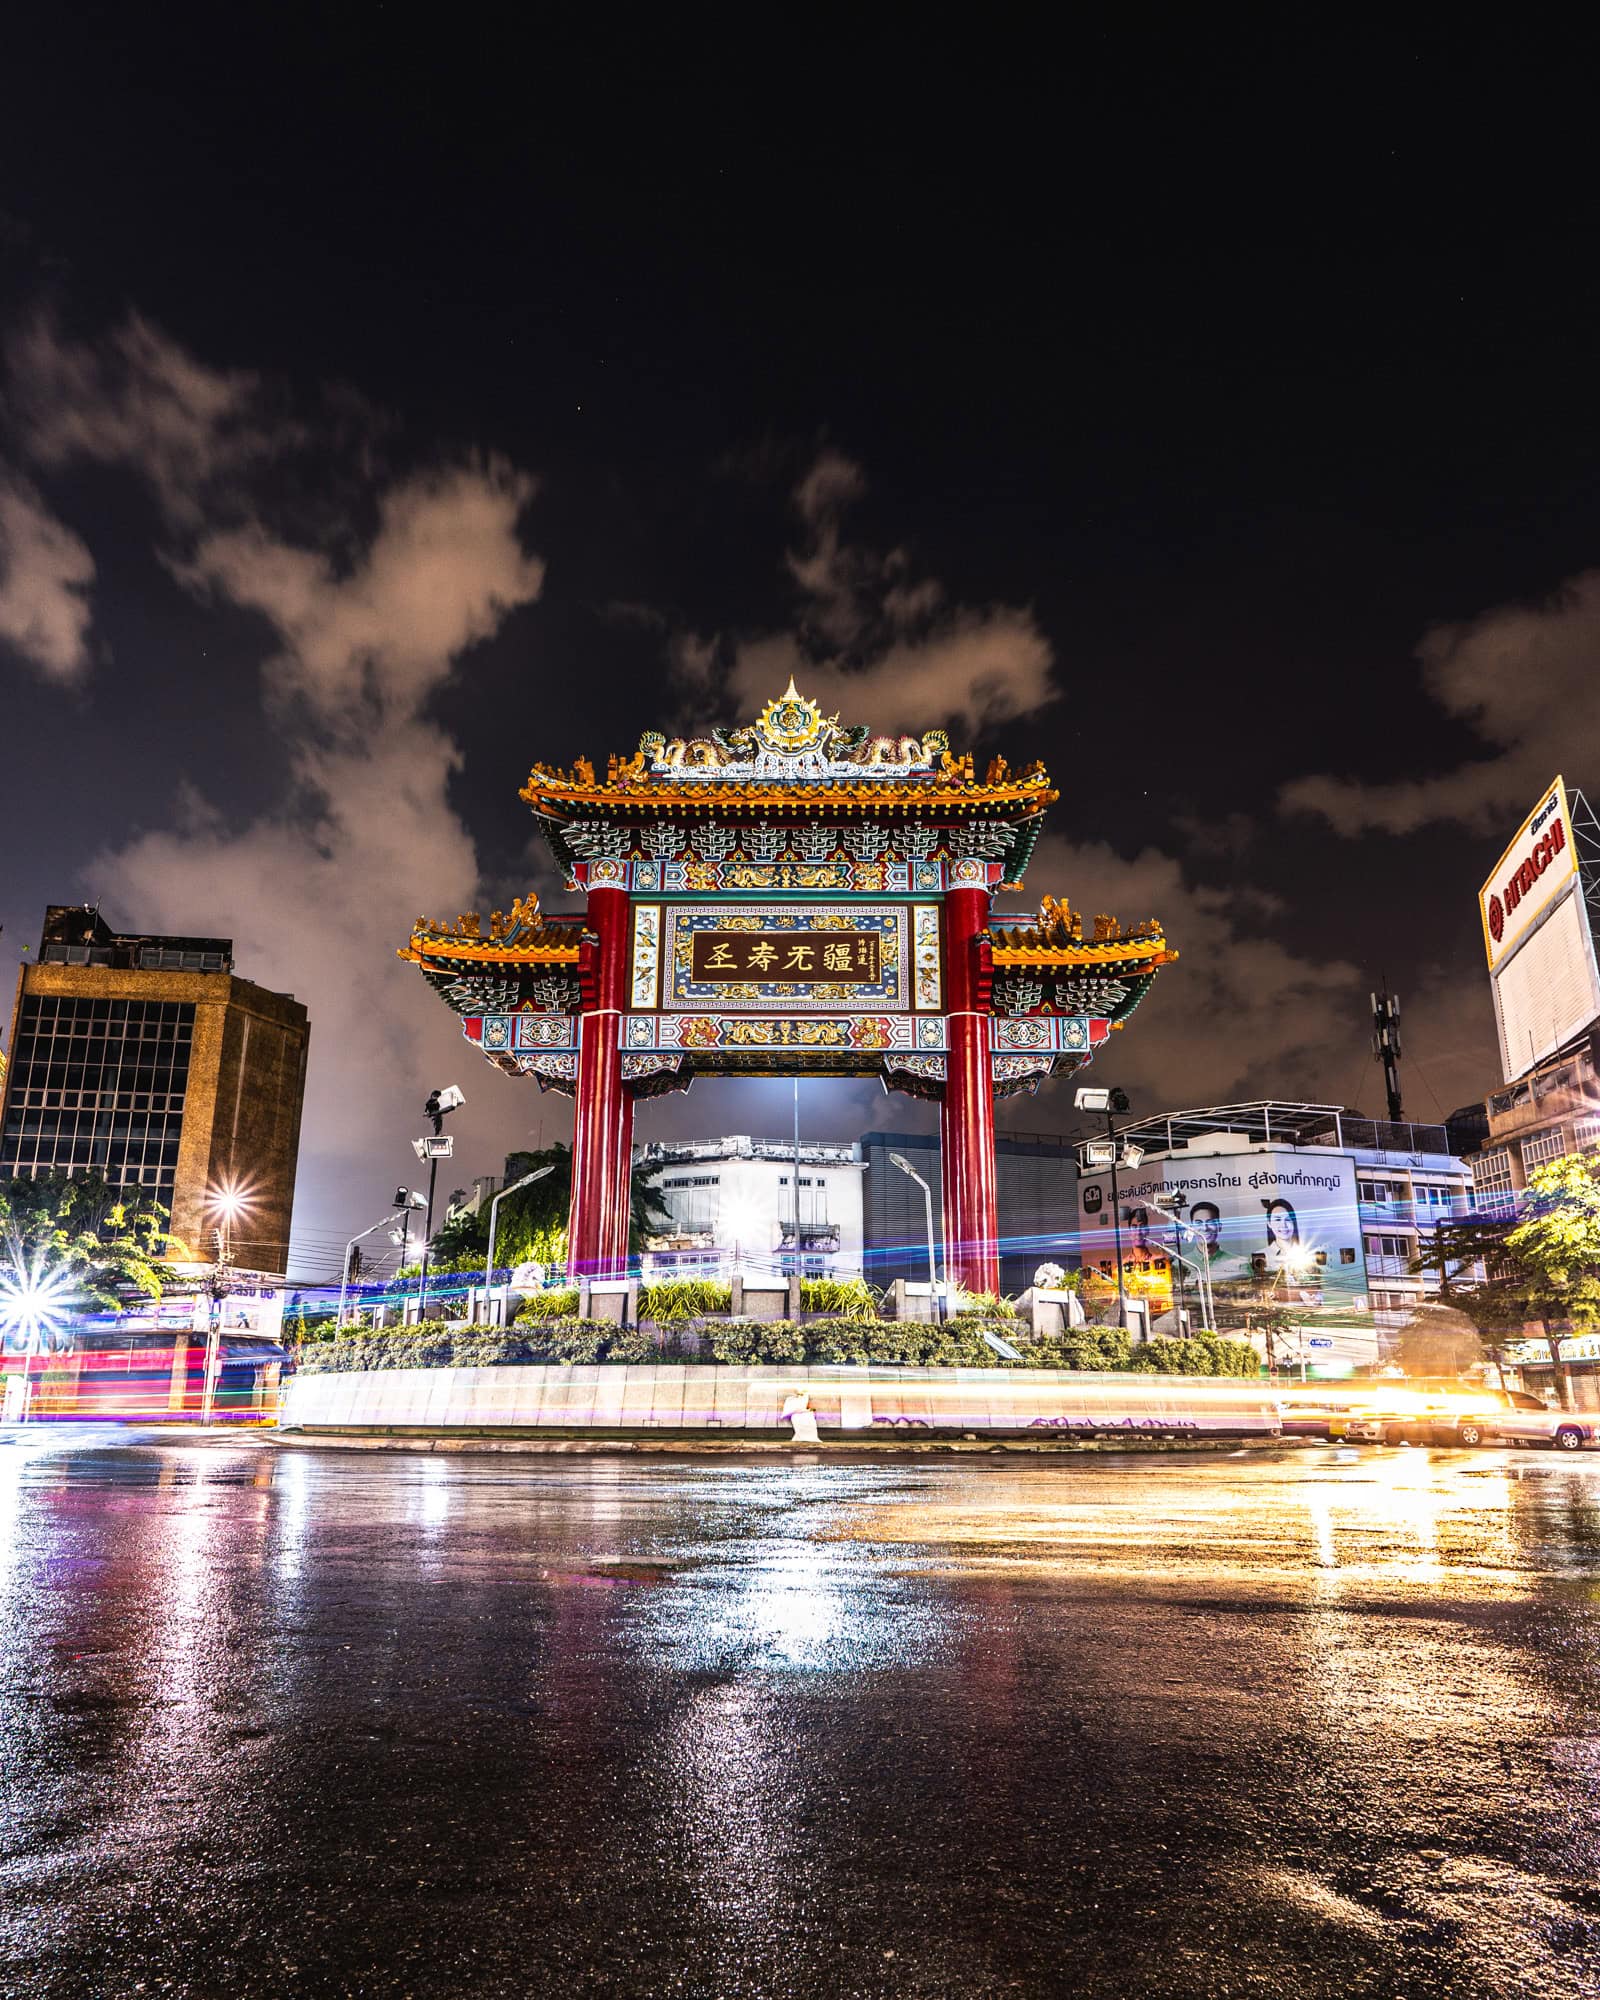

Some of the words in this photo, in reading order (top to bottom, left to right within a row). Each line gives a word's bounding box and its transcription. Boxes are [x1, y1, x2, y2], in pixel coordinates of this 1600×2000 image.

[1503, 818, 1567, 917] HITACHI
[703, 941, 854, 973] 圣寿无疆
[1107, 1172, 1242, 1202] ยระดับชีวิตเกษตรกรไทย
[1248, 1169, 1341, 1191] สู่สังคมที่ภาคภูมิ
